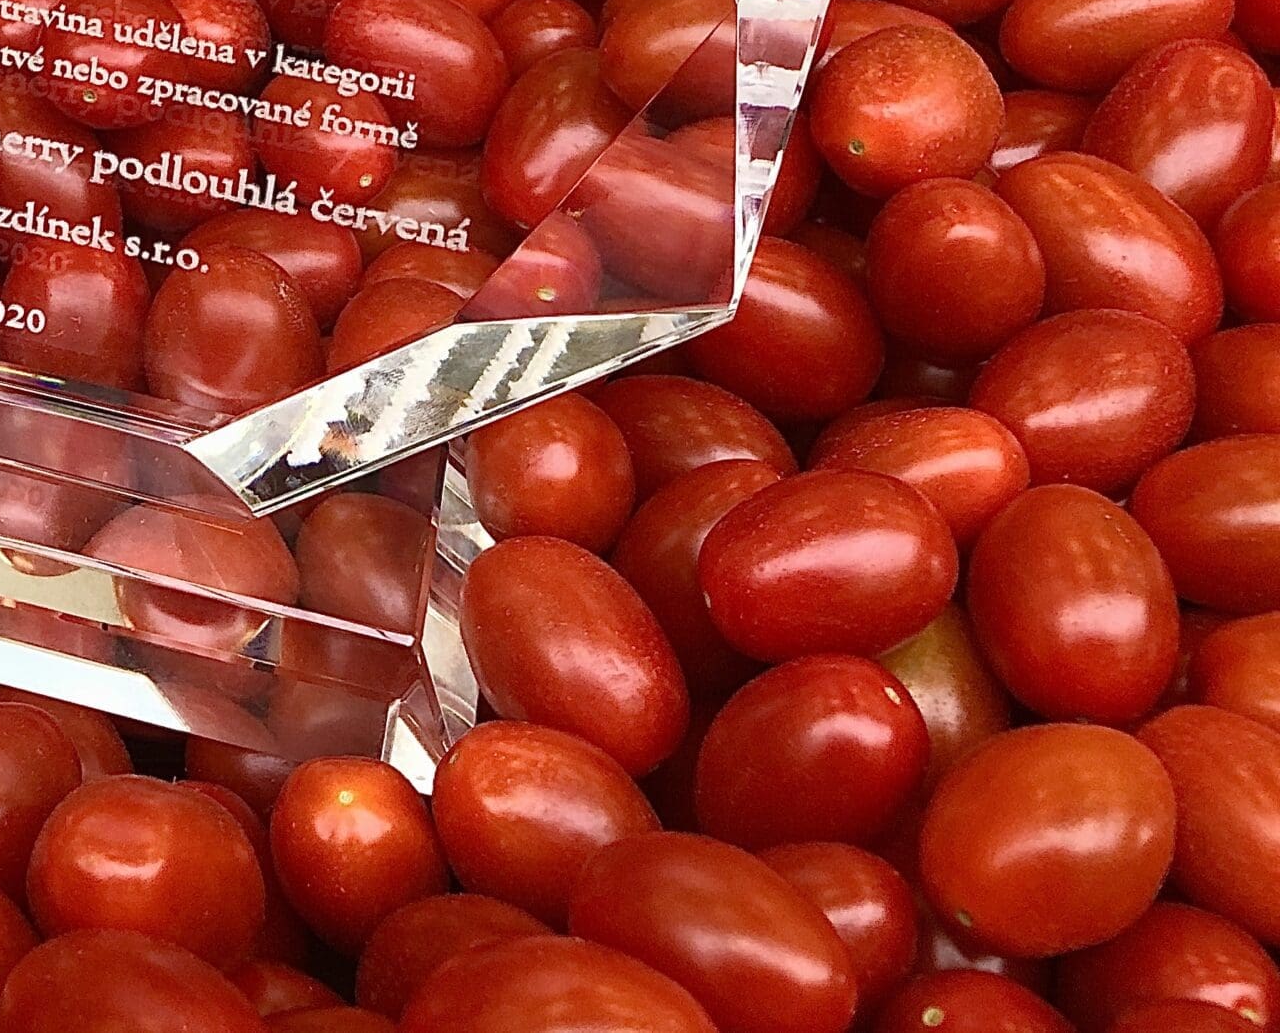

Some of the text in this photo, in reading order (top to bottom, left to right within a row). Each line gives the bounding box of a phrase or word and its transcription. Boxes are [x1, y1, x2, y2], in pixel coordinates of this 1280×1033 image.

[113, 20, 236, 65] udělena
[245, 48, 267, 69] v
[271, 44, 417, 101] kategorii
[53, 59, 129, 90] nebo
[137, 73, 312, 128] zpracované
[320, 104, 418, 150] formě
[90, 149, 299, 217] podlouhlá
[311, 187, 471, 253] červená
[123, 236, 210, 273] s.r.o.
